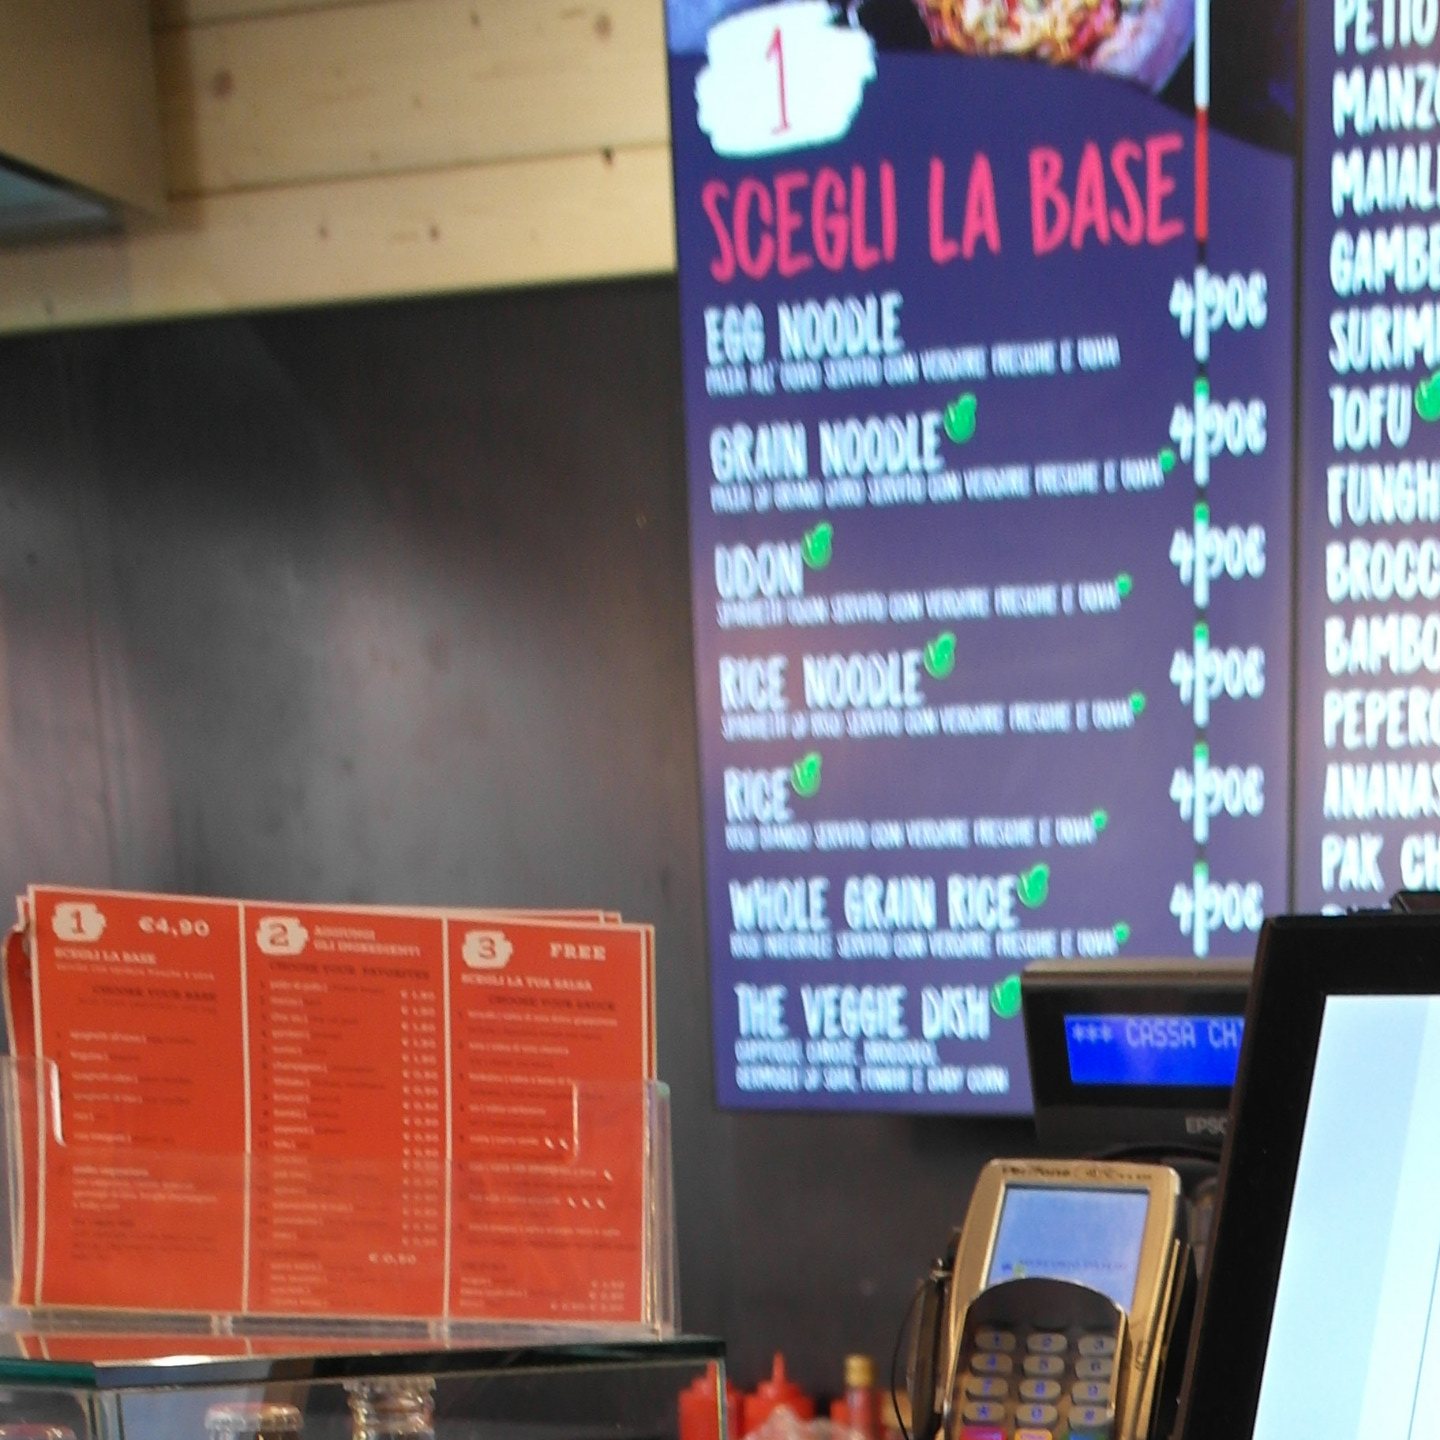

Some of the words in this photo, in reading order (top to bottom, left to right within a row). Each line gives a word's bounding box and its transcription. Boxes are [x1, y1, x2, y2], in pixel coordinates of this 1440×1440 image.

[766, 26, 790, 135] 1
[702, 161, 898, 283] SCEGLI
[927, 153, 1001, 264] LA
[1029, 137, 1186, 256] BASE
[704, 302, 765, 366] EGG
[777, 291, 905, 361] NOODLE
[1168, 271, 1268, 340] 490€
[1168, 398, 1268, 466] 490€
[1328, 382, 1412, 452] TOFU
[709, 421, 808, 484] GRAIN
[818, 411, 945, 480] NOODLE
[714, 540, 804, 599] UDON
[1168, 524, 1267, 587] 490€
[719, 653, 789, 712] RICE
[802, 650, 925, 710] NOODLE
[1168, 646, 1266, 706] 490€
[724, 766, 795, 824] RICE
[1168, 765, 1265, 823] 490€
[1321, 832, 1385, 891] PAK
[138, 915, 210, 938] €4,90
[729, 876, 832, 932] WHOLE
[844, 874, 938, 931] GRAIN
[947, 872, 1021, 931] RICE
[1168, 880, 1264, 938] 490€
[269, 922, 291, 948] 2
[478, 936, 497, 960] 3
[550, 941, 606, 962] FREE
[734, 981, 789, 1040] THE
[801, 982, 908, 1041] VEGGIE
[921, 983, 991, 1042] DISH
[1126, 1018, 1196, 1049] CASSA
[1207, 1019, 1243, 1049] CH
[1185, 1115, 1228, 1136] EPSO
